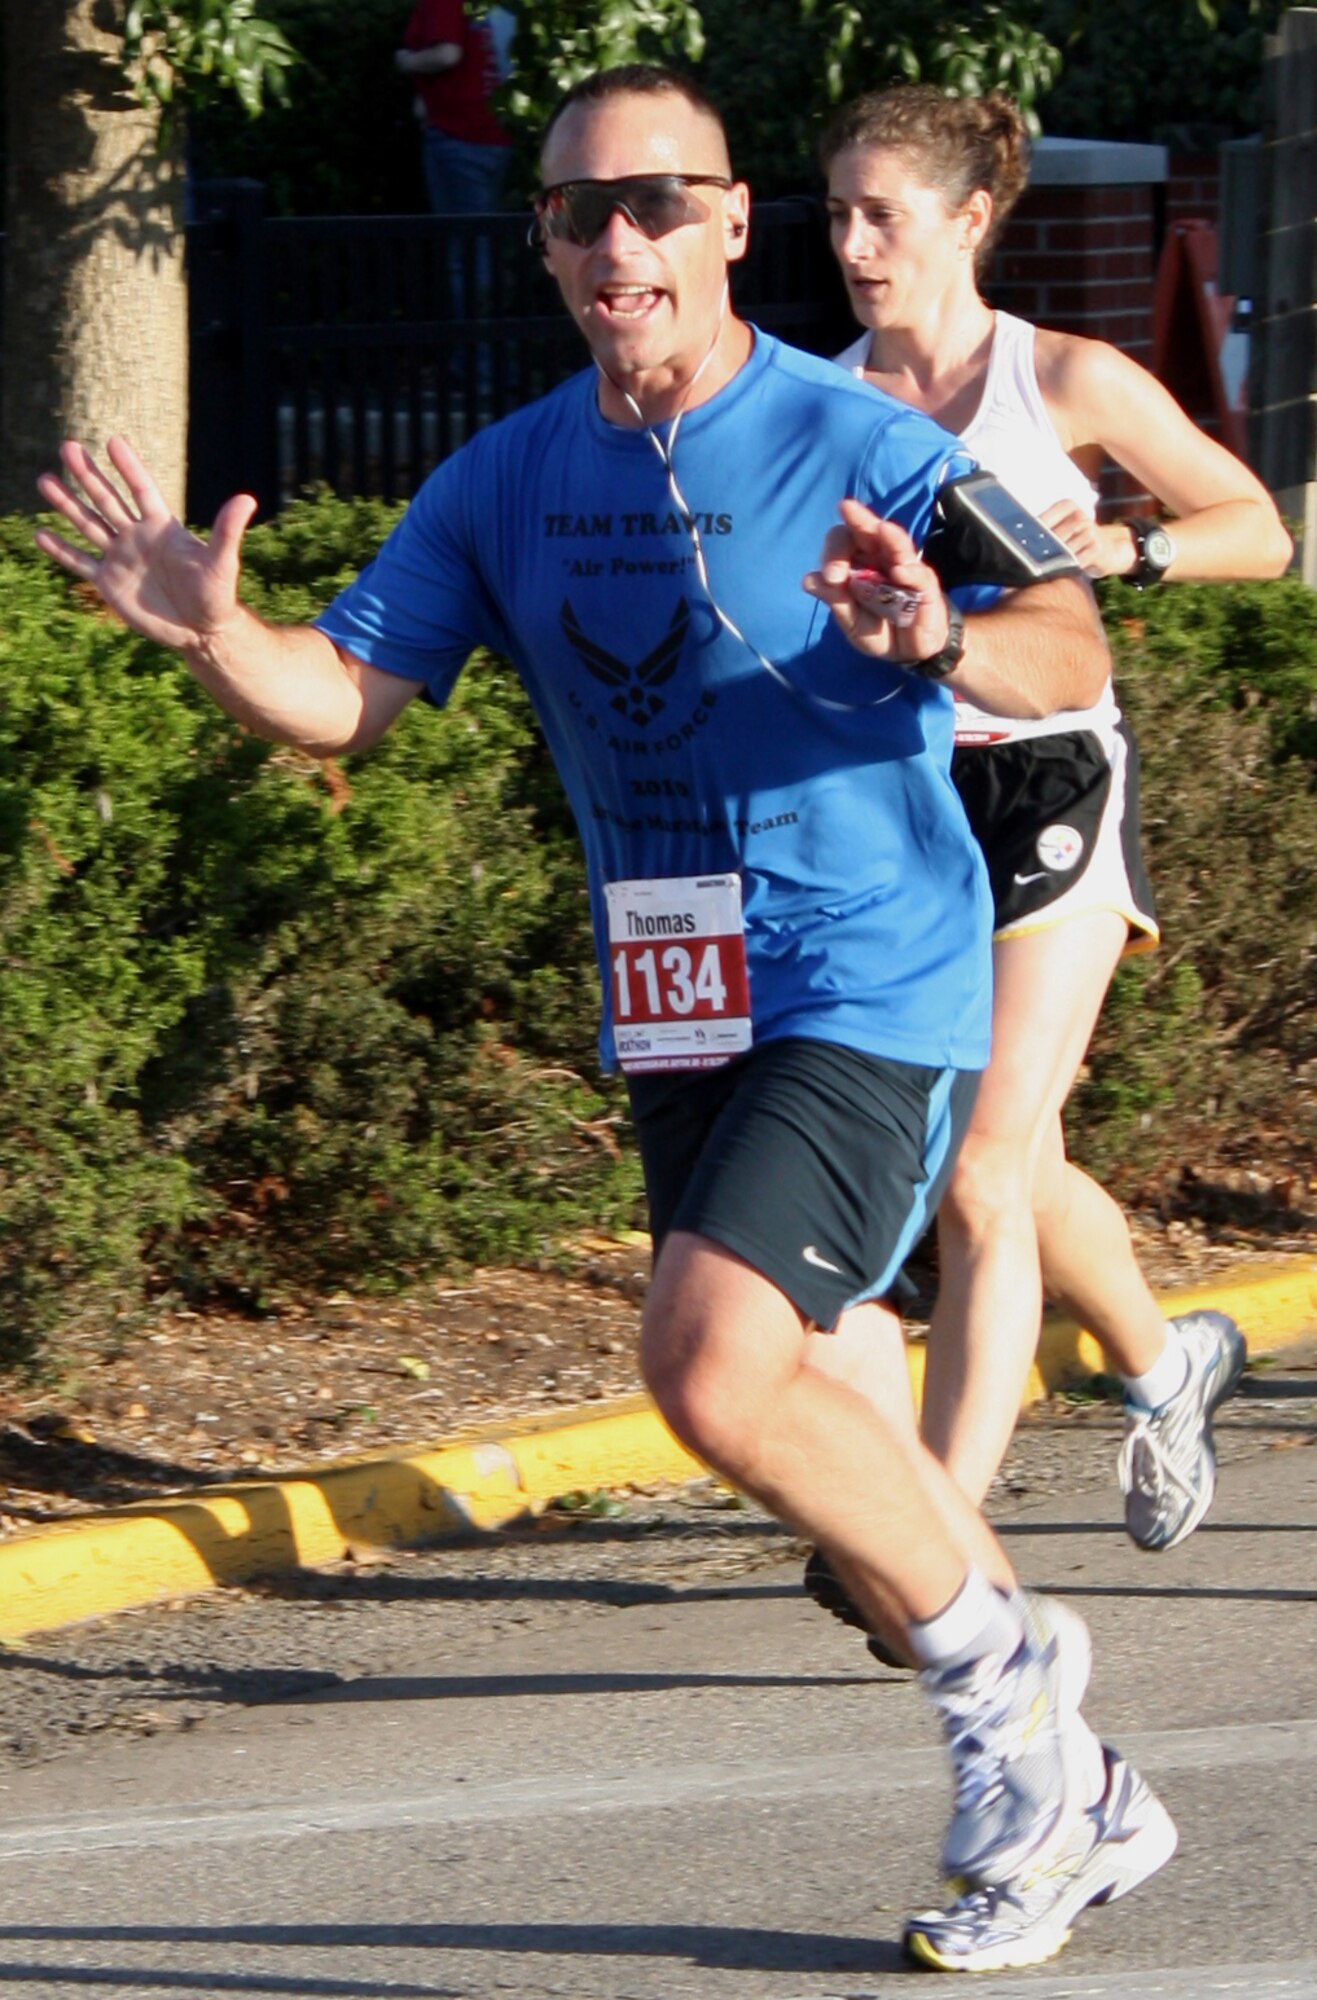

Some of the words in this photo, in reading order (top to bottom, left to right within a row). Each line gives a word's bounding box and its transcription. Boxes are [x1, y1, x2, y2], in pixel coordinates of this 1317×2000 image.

[544, 514, 612, 537] TEAM
[620, 513, 733, 537] TRAVIS
[735, 810, 799, 837] Team
[626, 910, 695, 937] Thomas
[613, 943, 727, 1017] 1134
